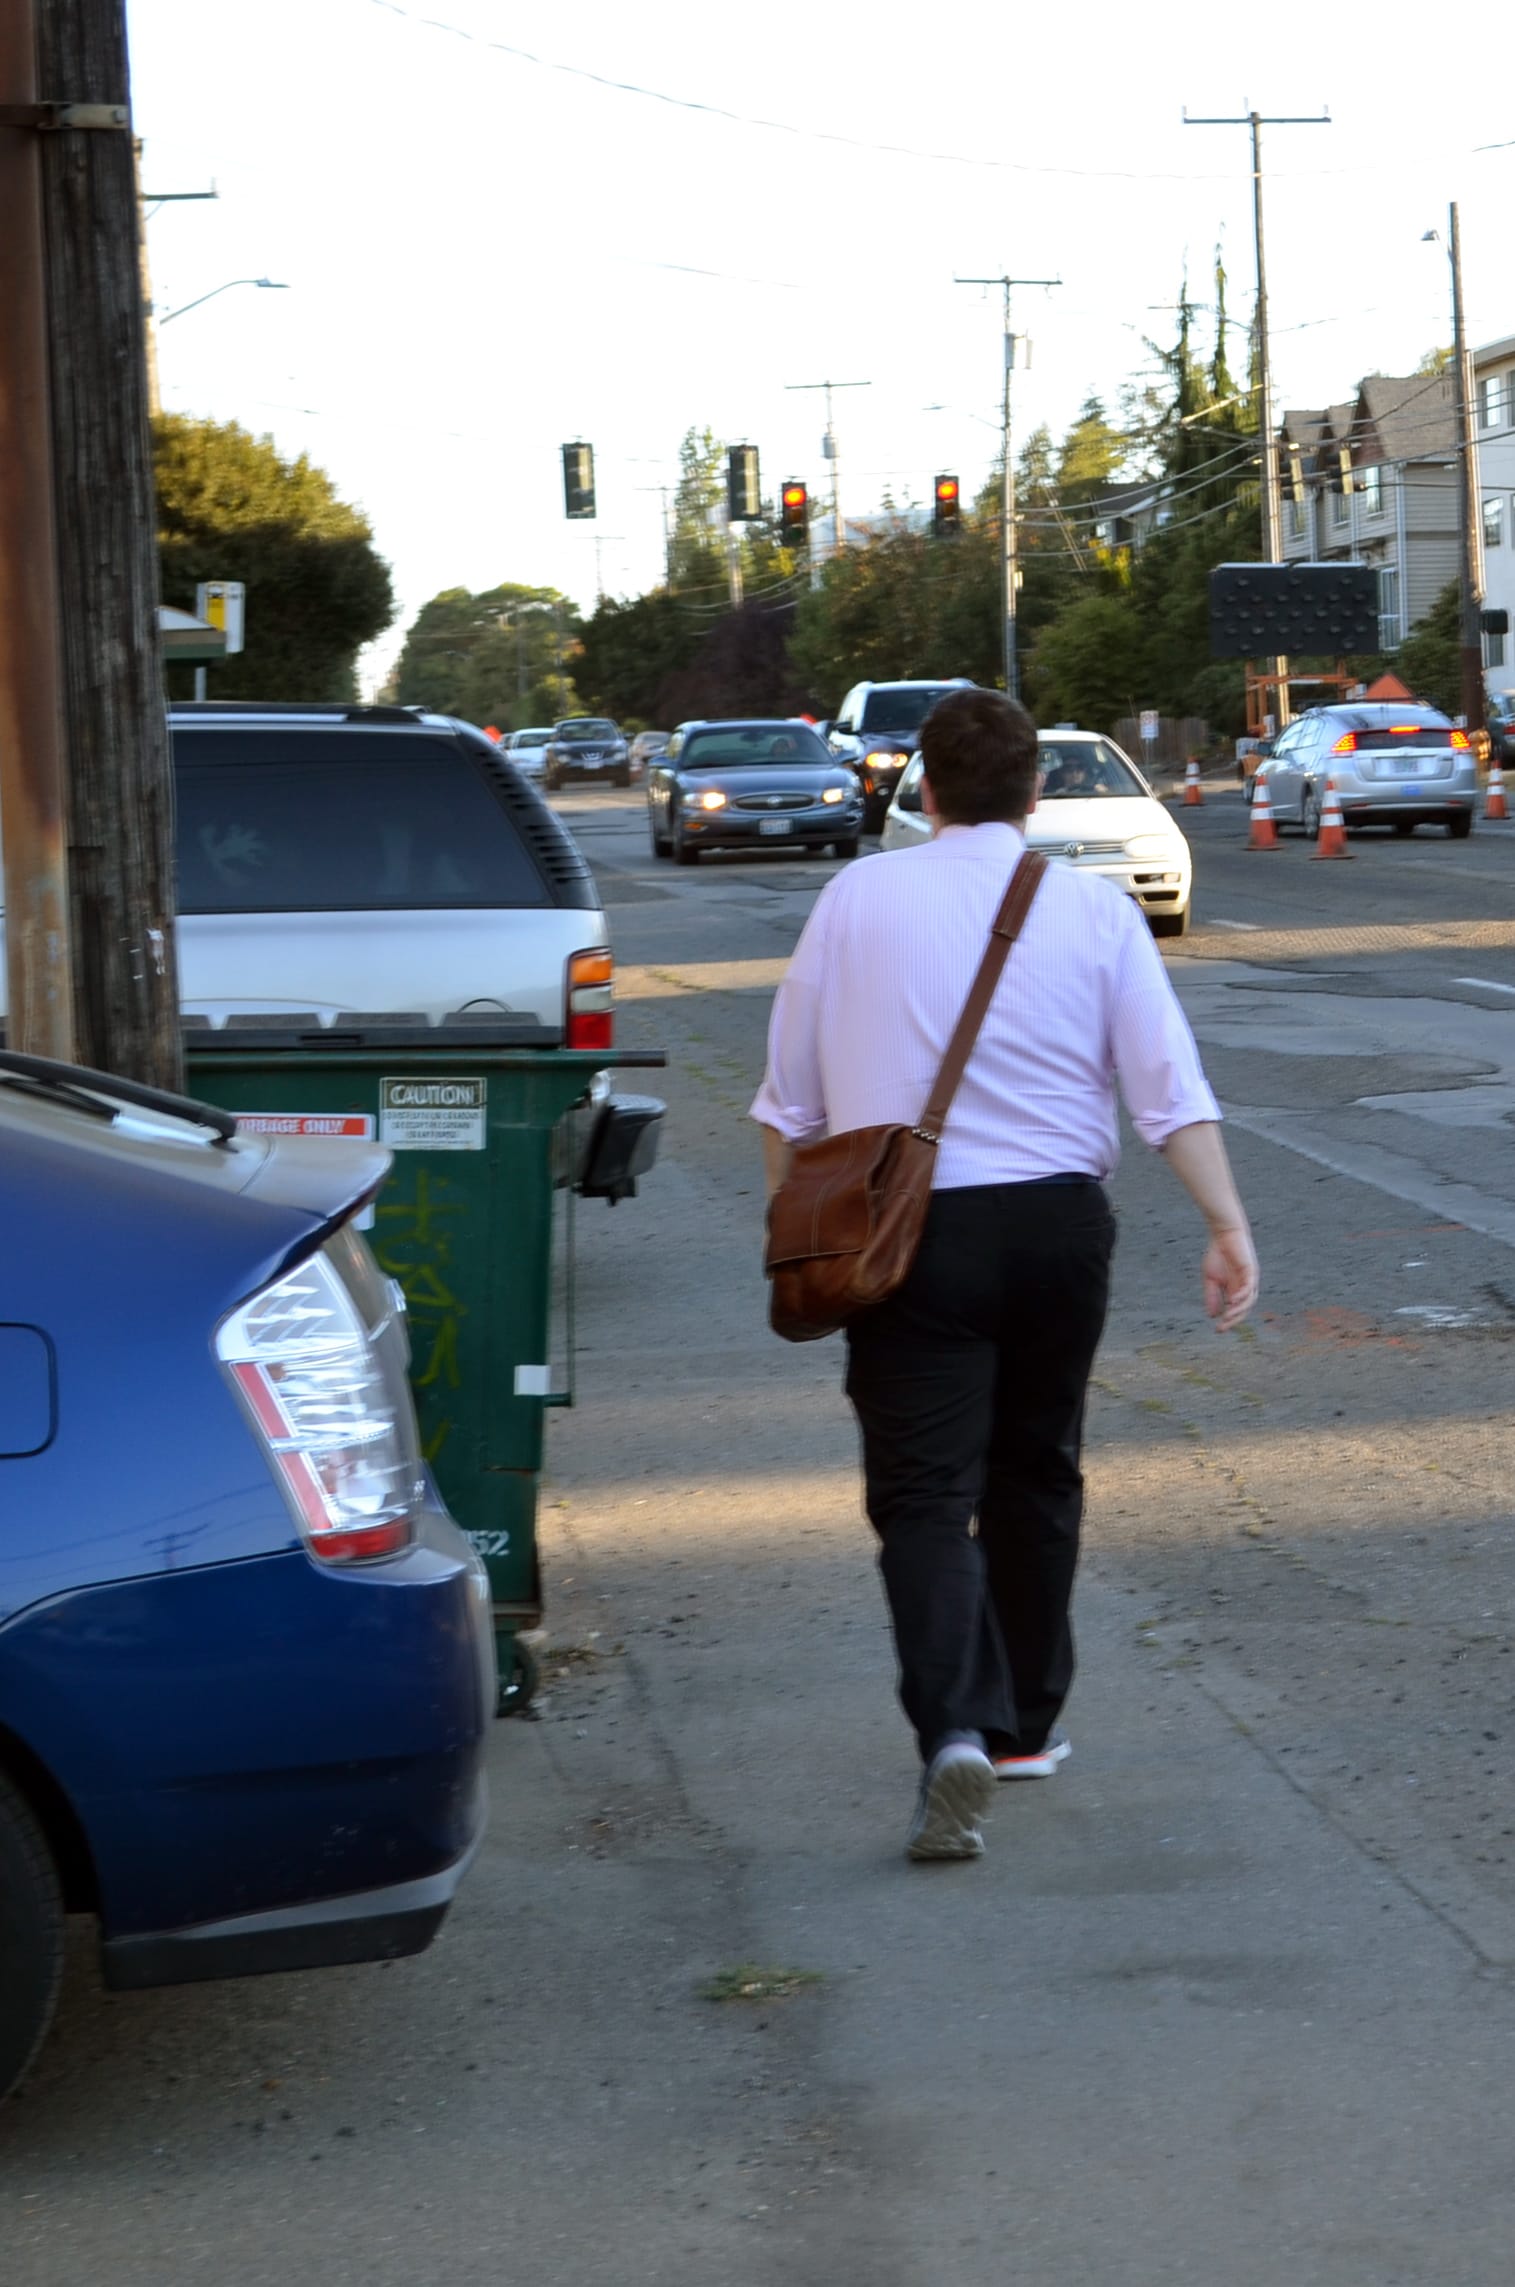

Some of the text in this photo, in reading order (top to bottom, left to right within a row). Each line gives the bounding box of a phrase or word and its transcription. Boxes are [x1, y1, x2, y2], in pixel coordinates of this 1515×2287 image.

[390, 1085, 474, 1105] CAUTION
[236, 1118, 346, 1133] ARBAGE ONLY
